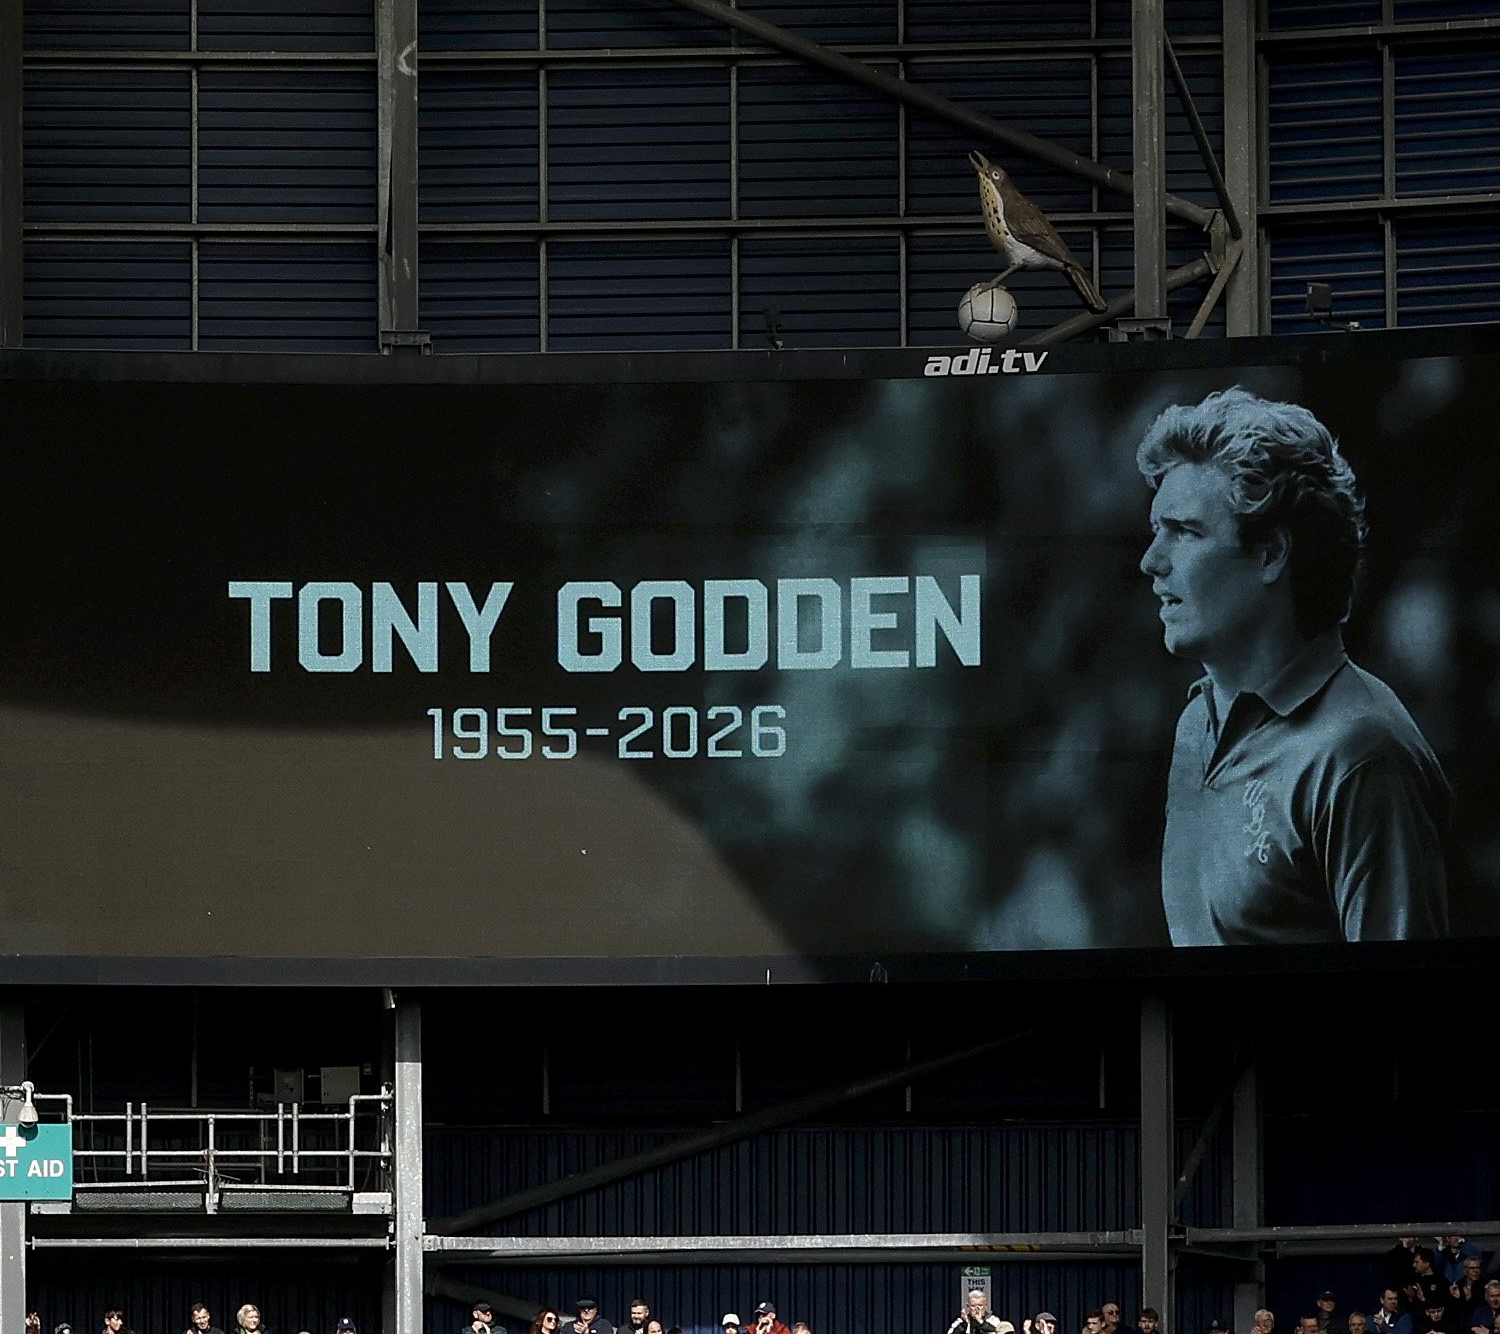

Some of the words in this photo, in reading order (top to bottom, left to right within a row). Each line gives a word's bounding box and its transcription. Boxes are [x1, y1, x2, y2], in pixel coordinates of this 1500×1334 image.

[924, 347, 1048, 376] adi.tv
[228, 580, 514, 673] TONY
[557, 574, 981, 672] GODDEN
[427, 705, 787, 759] 1955-2026
[27, 1159, 65, 1178] AID
[967, 1278, 986, 1286] THIS
